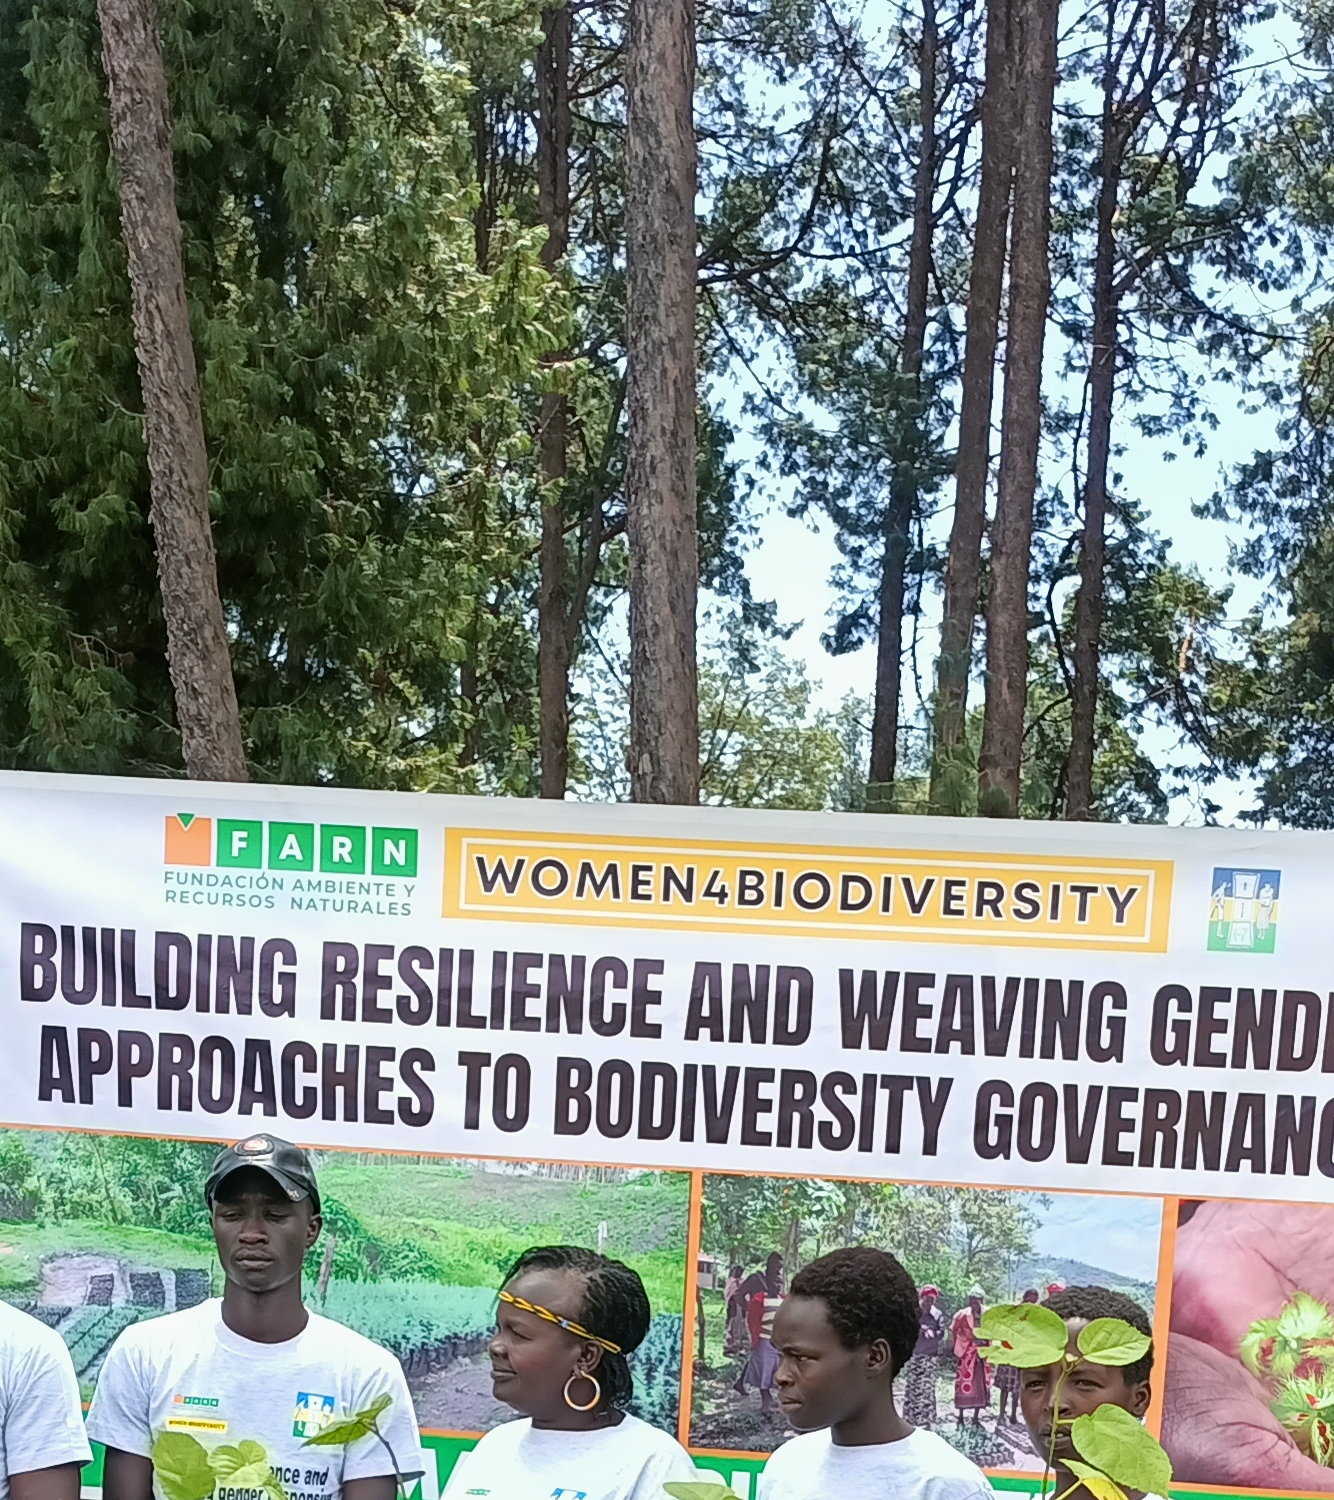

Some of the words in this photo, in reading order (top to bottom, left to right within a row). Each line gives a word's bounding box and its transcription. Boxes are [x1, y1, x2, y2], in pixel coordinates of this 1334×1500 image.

[231, 831, 406, 866] FARN
[164, 871, 284, 891] FUNDACIÓN
[292, 879, 395, 897] AMBIENTE
[404, 884, 415, 898] Y
[475, 856, 1139, 924] WOMEN4BIODIVERSITY
[165, 890, 275, 909] RECURSOS
[290, 897, 412, 916] NATURALES
[19, 922, 297, 1018] BUILDING
[319, 941, 665, 1039] RESILIENCE
[683, 961, 814, 1046] AND
[838, 968, 1128, 1064] WEAVING
[37, 1024, 436, 1128] APPROACHES
[457, 1050, 532, 1133] TO
[553, 1056, 955, 1157] BODIVERSITY
[304, 1466, 329, 1486] and
